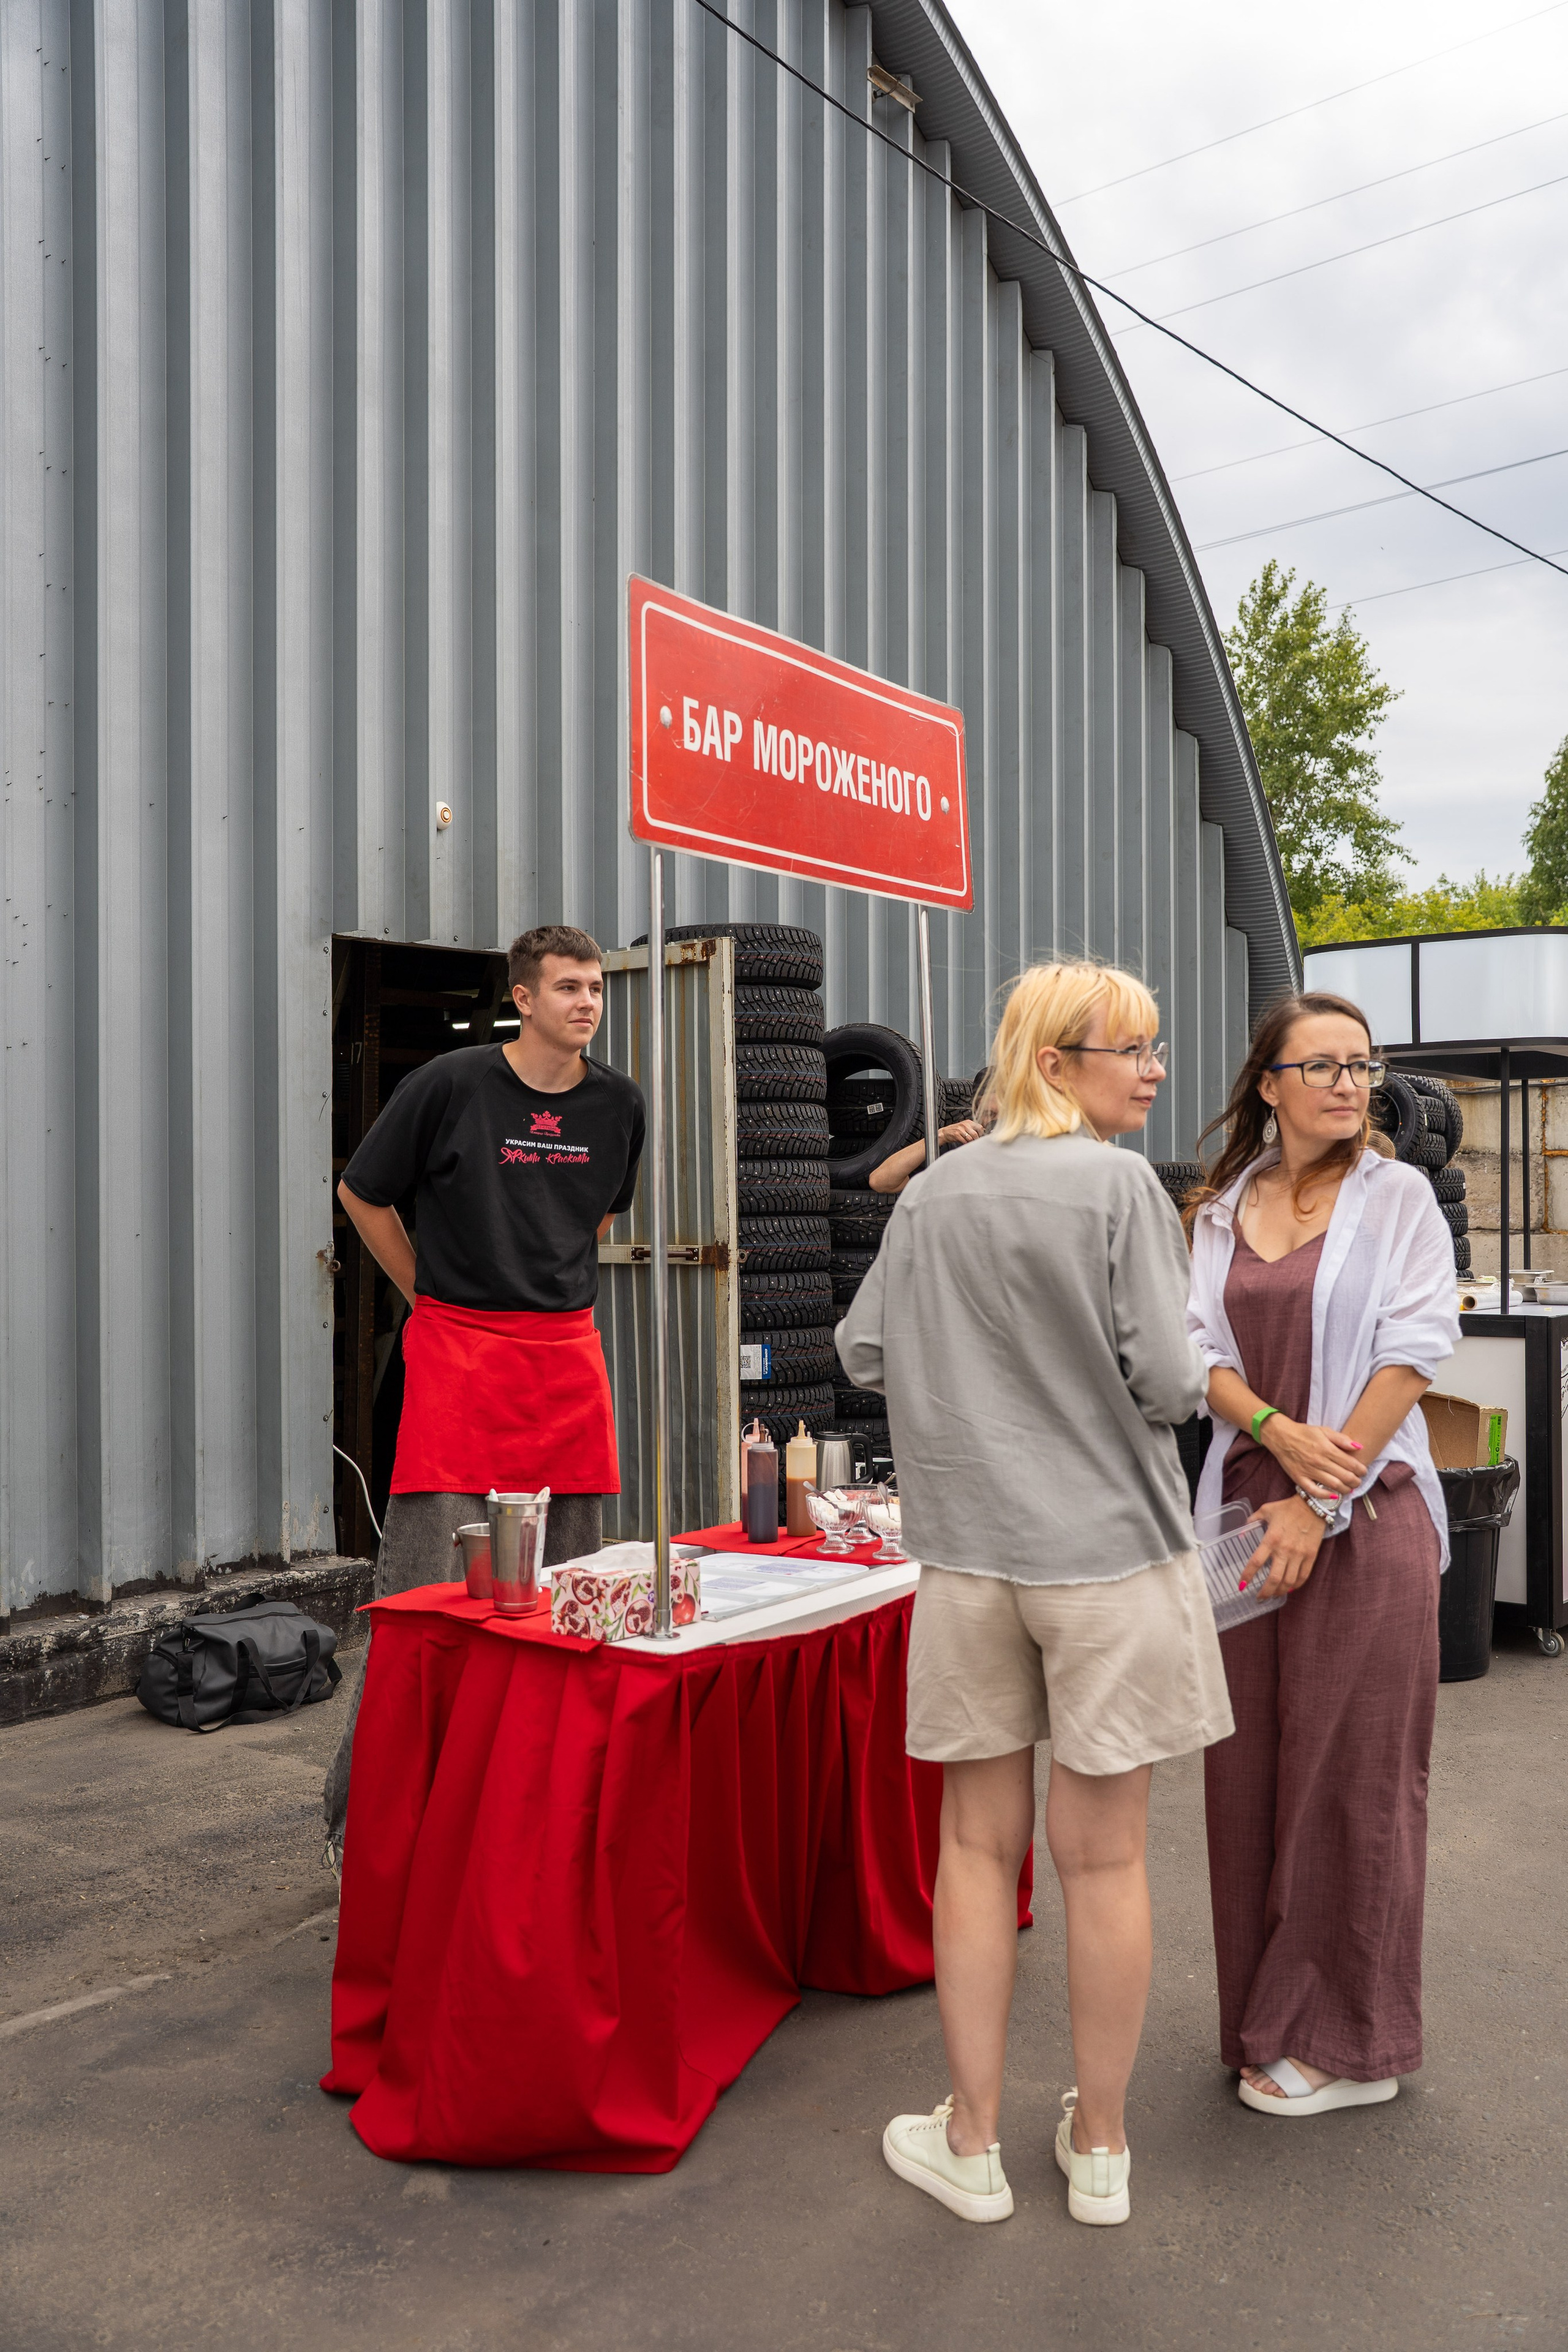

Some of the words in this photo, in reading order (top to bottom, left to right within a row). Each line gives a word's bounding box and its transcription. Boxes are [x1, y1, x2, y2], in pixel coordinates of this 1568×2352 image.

[682, 696, 743, 763] БАР
[753, 719, 932, 821] МОРОЖЕНОГО
[505, 1138, 536, 1148] УКРАСИМ
[554, 1144, 589, 1153] ПРАЗДНИК
